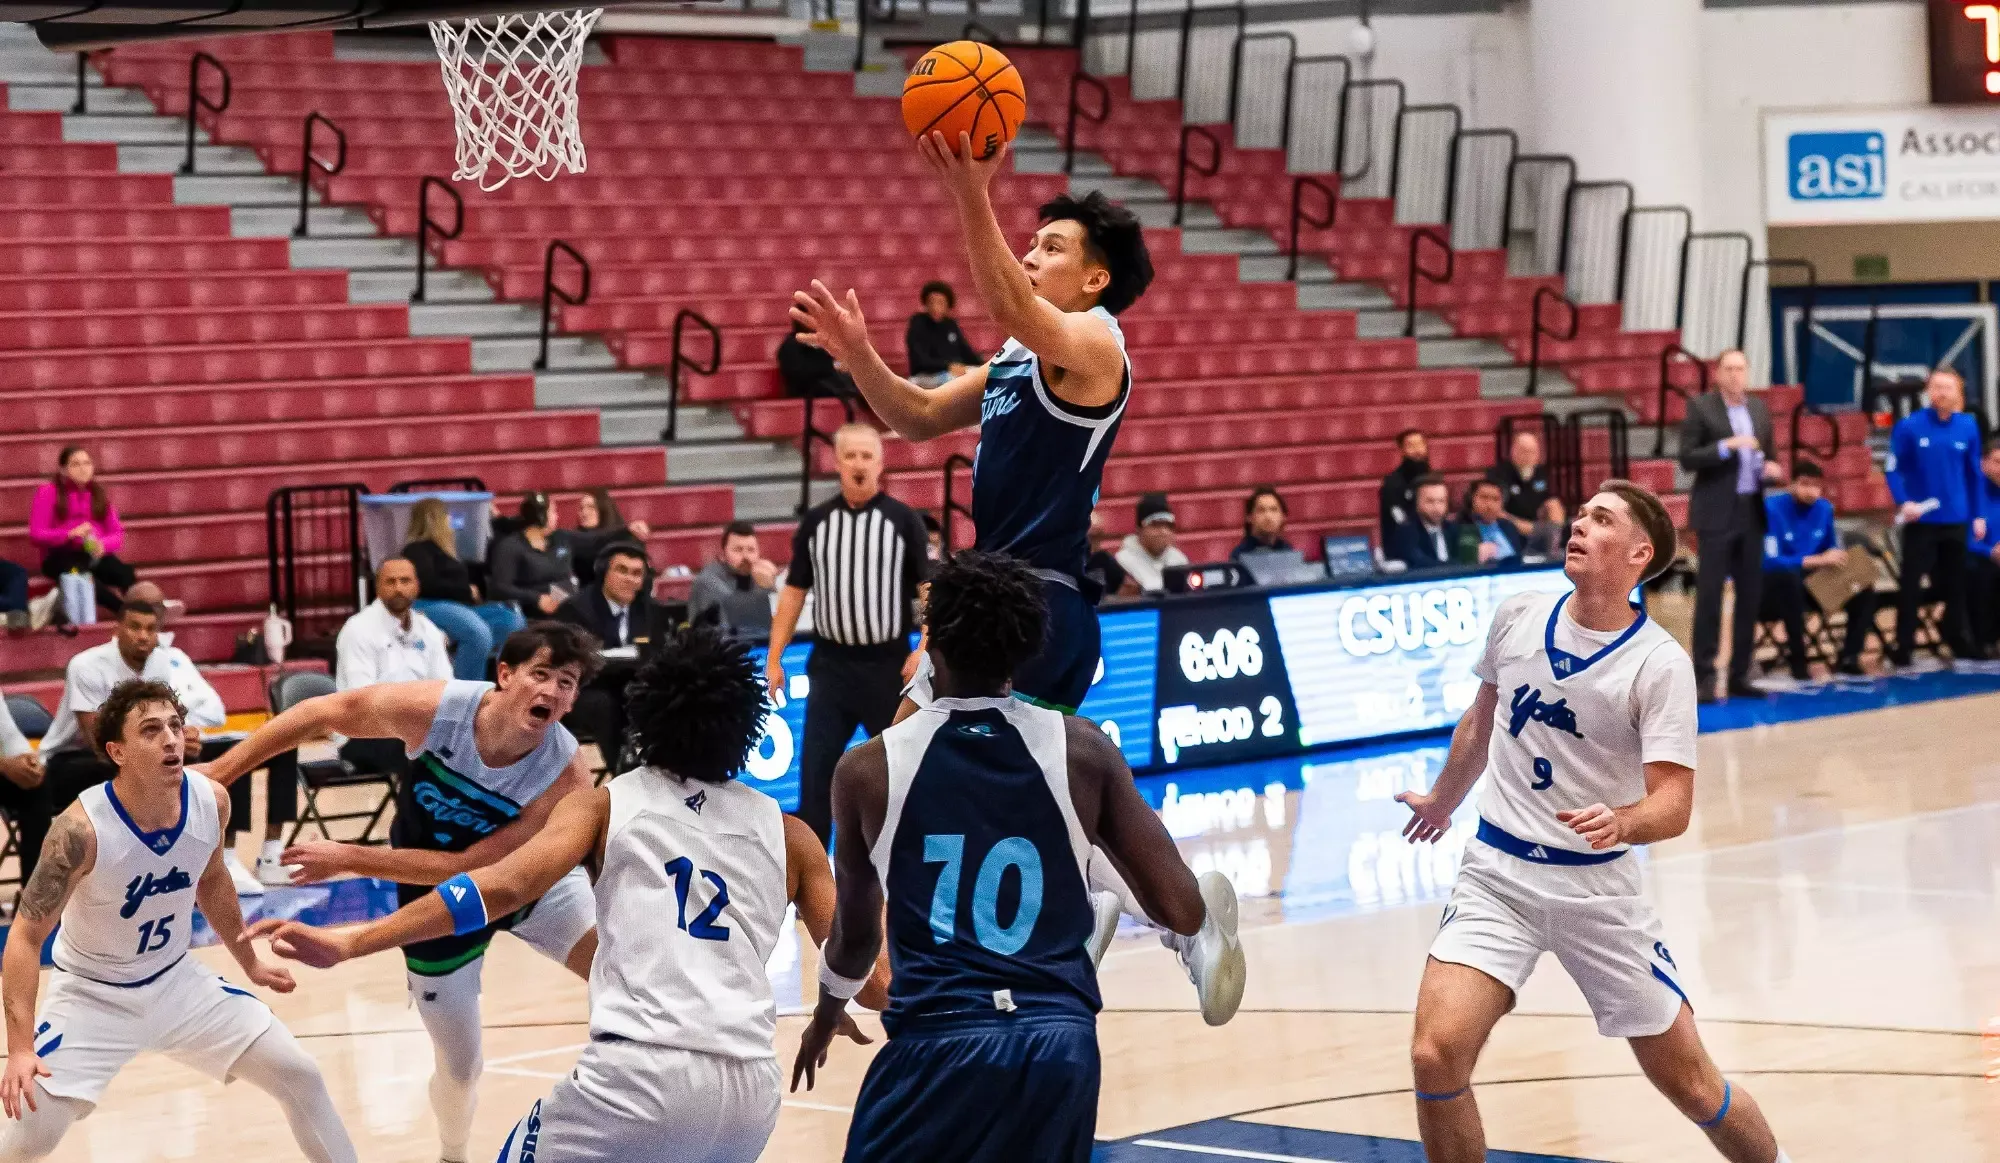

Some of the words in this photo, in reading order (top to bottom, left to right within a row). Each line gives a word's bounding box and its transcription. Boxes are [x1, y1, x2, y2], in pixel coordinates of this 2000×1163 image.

[1797, 136, 1884, 197] asi
[1338, 587, 1477, 656] CSUSB
[1179, 626, 1263, 682] 6:06
[1259, 695, 1284, 737] 2
[1531, 757, 1554, 790] 9
[665, 856, 730, 941] 12
[923, 834, 1043, 955] 10
[136, 913, 175, 955] 15
